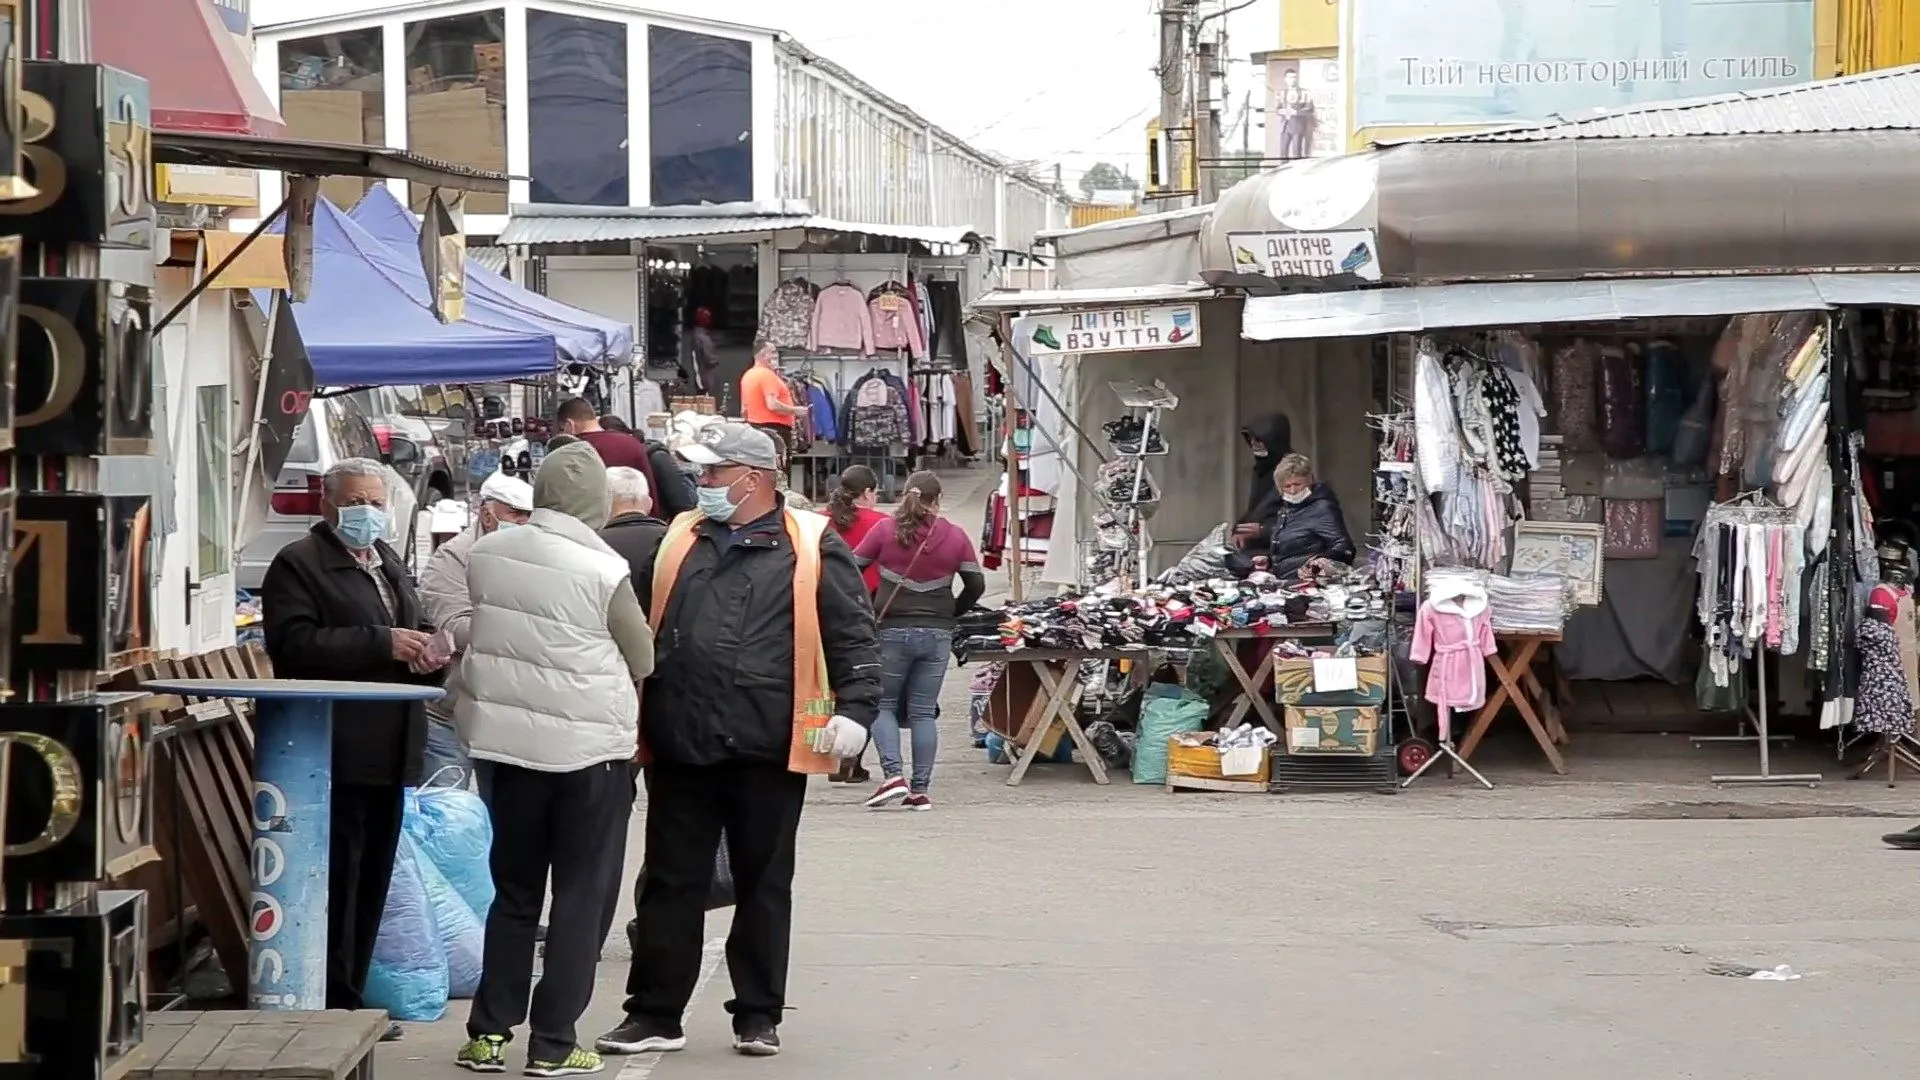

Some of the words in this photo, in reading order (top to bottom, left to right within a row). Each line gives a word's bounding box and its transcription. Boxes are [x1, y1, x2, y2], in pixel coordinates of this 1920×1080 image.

[1400, 57, 1463, 86] Твій
[1478, 53, 1688, 87] неповторний
[1702, 56, 1797, 80] стиль
[1272, 259, 1335, 277] ВЗУТТЯ
[1071, 310, 1151, 331] ДИТЯЧЕ
[1067, 327, 1160, 350] ВЗУТТЯ
